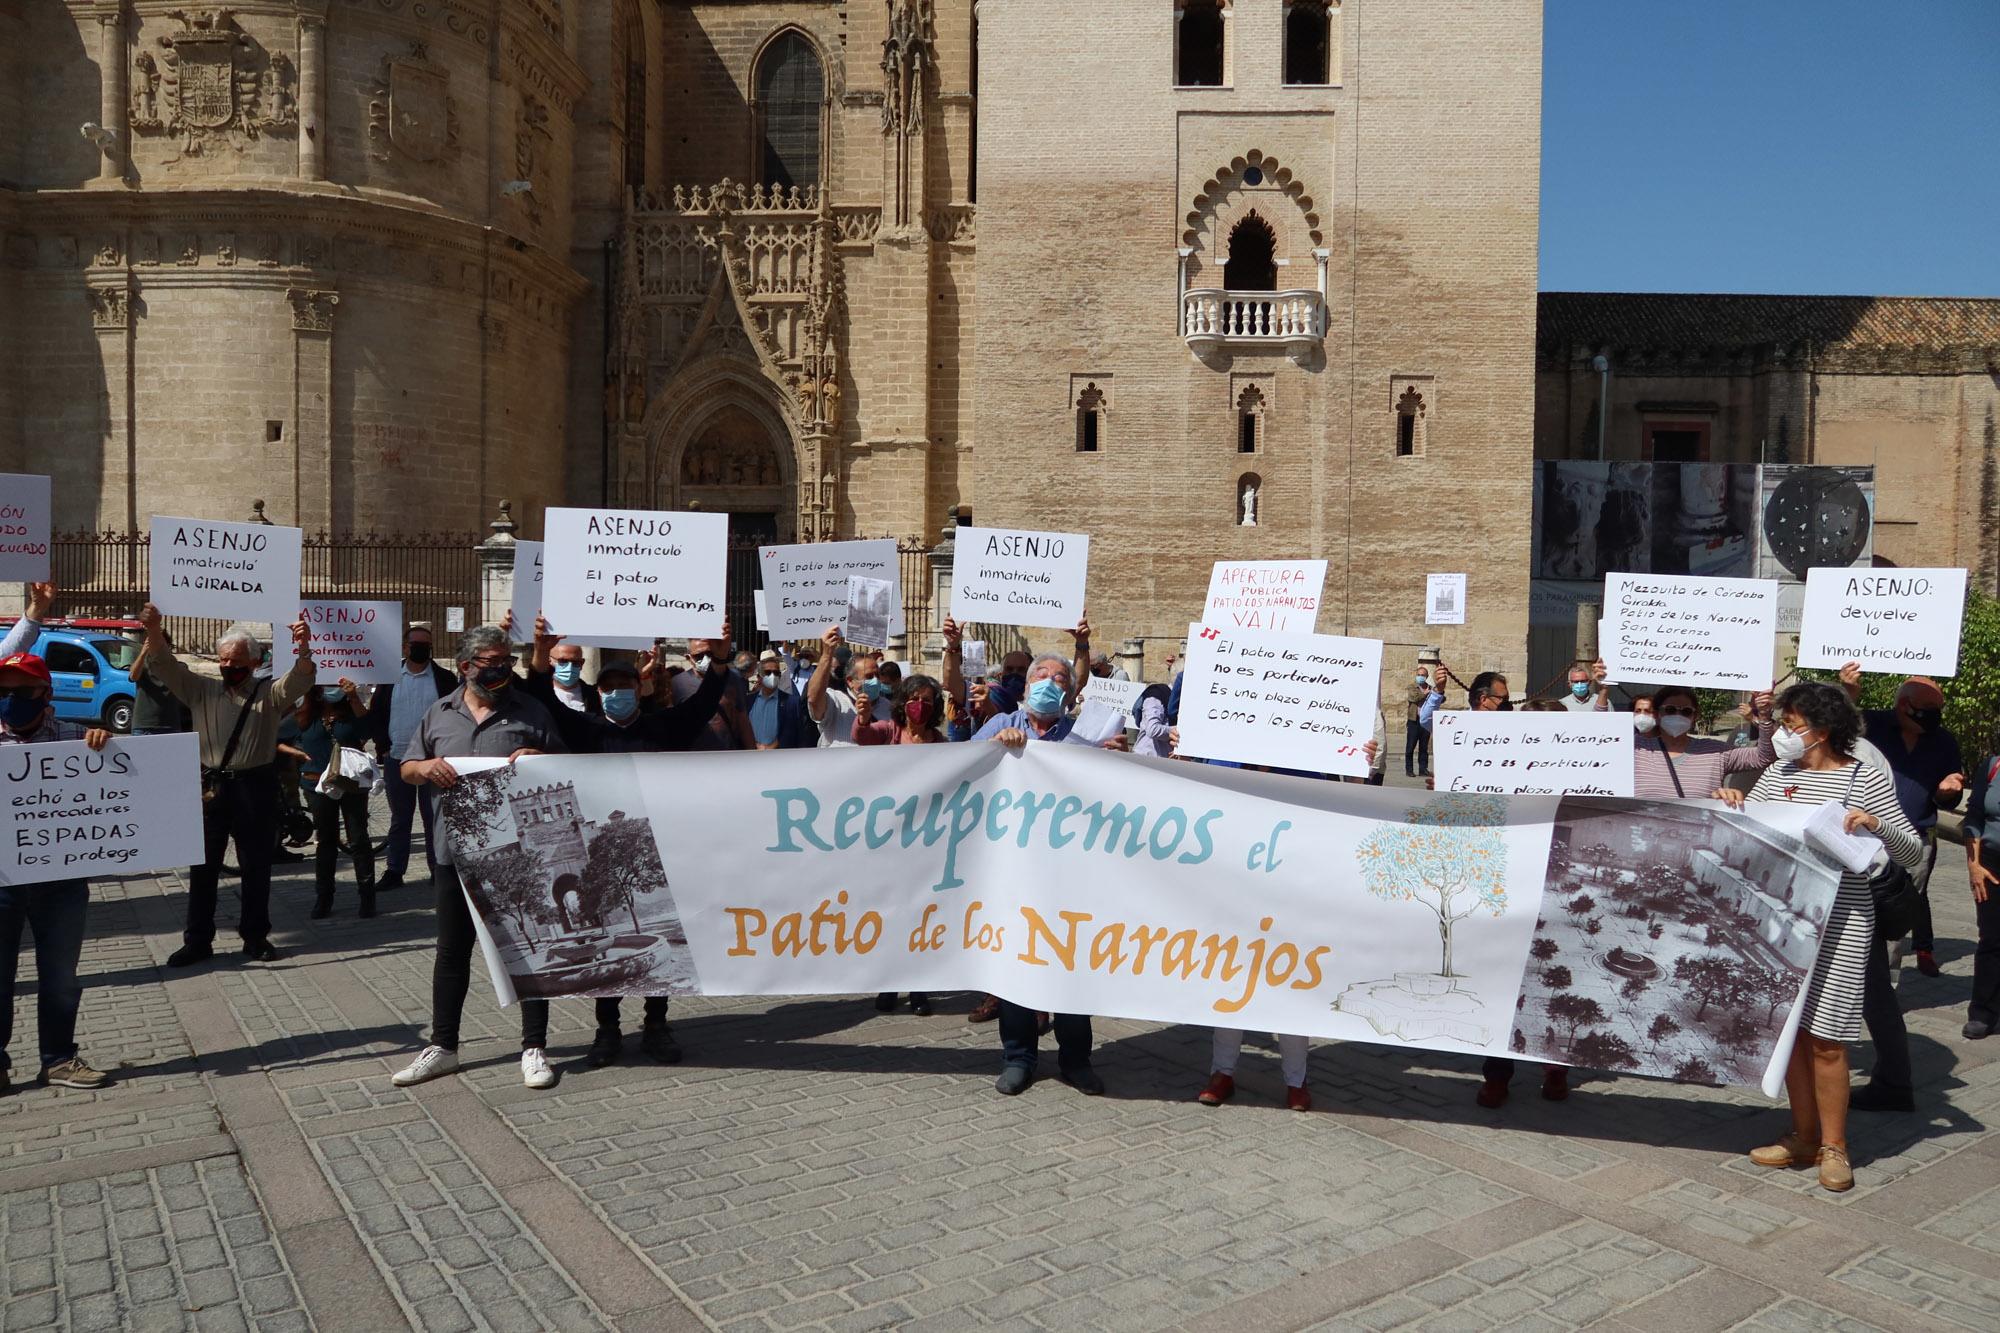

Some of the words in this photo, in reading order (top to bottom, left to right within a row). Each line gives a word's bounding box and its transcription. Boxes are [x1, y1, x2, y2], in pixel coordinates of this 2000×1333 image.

[587, 515, 672, 537] ASENJO
[173, 527, 267, 552] ASENJO
[985, 534, 1065, 559] ASENJO
[587, 543, 683, 557] inmatriculó
[173, 557, 259, 571] inmatriculó
[778, 562, 790, 574] El
[795, 561, 824, 574] patio
[172, 574, 190, 588] LA
[194, 576, 264, 594] GIRALDA
[586, 569, 602, 581] El
[613, 571, 658, 584] patio
[979, 565, 1052, 584] inmatriculó
[1220, 567, 1306, 585] APERTURA
[1241, 586, 1289, 596] PUBLICA
[1692, 587, 1708, 596] de
[1713, 586, 1765, 600] Córdoba
[1845, 576, 1934, 597] ASENJO:
[585, 591, 605, 605] de
[613, 592, 638, 607] los
[646, 593, 716, 613] Naranjos
[782, 597, 798, 609] Es
[827, 597, 849, 607] plaz
[962, 585, 1000, 602] Santa
[1007, 591, 1064, 609] Catalina
[1213, 597, 1243, 609] PATIO
[1244, 597, 1264, 608] LOS
[1265, 596, 1316, 610] NARANJOS
[1621, 594, 1668, 608] Giralda
[301, 606, 376, 624] ASENJO
[786, 616, 816, 626] como
[1619, 607, 1656, 618] Patio
[1660, 610, 1677, 621] de
[1706, 612, 1762, 627] Naranjos
[1840, 604, 1919, 622] devuelve
[1619, 620, 1649, 633] San
[1656, 623, 1711, 637] Lorenzo
[1865, 623, 1881, 636] lo
[1216, 639, 1234, 654] El
[1240, 646, 1276, 659] patio
[1618, 634, 1659, 649] Santa
[1665, 640, 1722, 653] Catalina
[320, 659, 375, 669] SEVILLA
[1618, 647, 1691, 664] Catedral
[1213, 663, 1232, 674] no
[1236, 666, 1255, 677] es
[1262, 669, 1341, 686] particular
[1091, 679, 1129, 693] ASENJO
[1209, 682, 1228, 696] Es
[1234, 689, 1259, 700] una
[1264, 691, 1302, 706] plaza
[1306, 699, 1352, 714] pública
[1207, 708, 1257, 725] como
[1299, 719, 1356, 738] demás
[1453, 730, 1468, 746] El
[1473, 736, 1511, 749] patio
[1520, 732, 1542, 744] los
[1551, 731, 1621, 747] Naranjos
[1472, 758, 1492, 768] no
[1500, 758, 1516, 768] es
[1525, 757, 1611, 771] particular
[1450, 775, 1471, 793] Es
[1475, 784, 1504, 794] una
[1513, 784, 1554, 795] plaza
[1561, 783, 1616, 796] pública
[12, 788, 63, 807] echó
[72, 792, 87, 803] a
[100, 787, 130, 801] los
[15, 804, 131, 821] mercaderes
[17, 823, 140, 848] ESPADAS
[761, 780, 1223, 892] Recuperemos
[1247, 819, 1292, 874] el
[17, 852, 51, 866] los
[64, 846, 139, 866] protege
[724, 889, 883, 959] Patio
[906, 902, 946, 954] de
[963, 901, 1006, 954] los
[1016, 904, 1332, 1014] Naranjos
